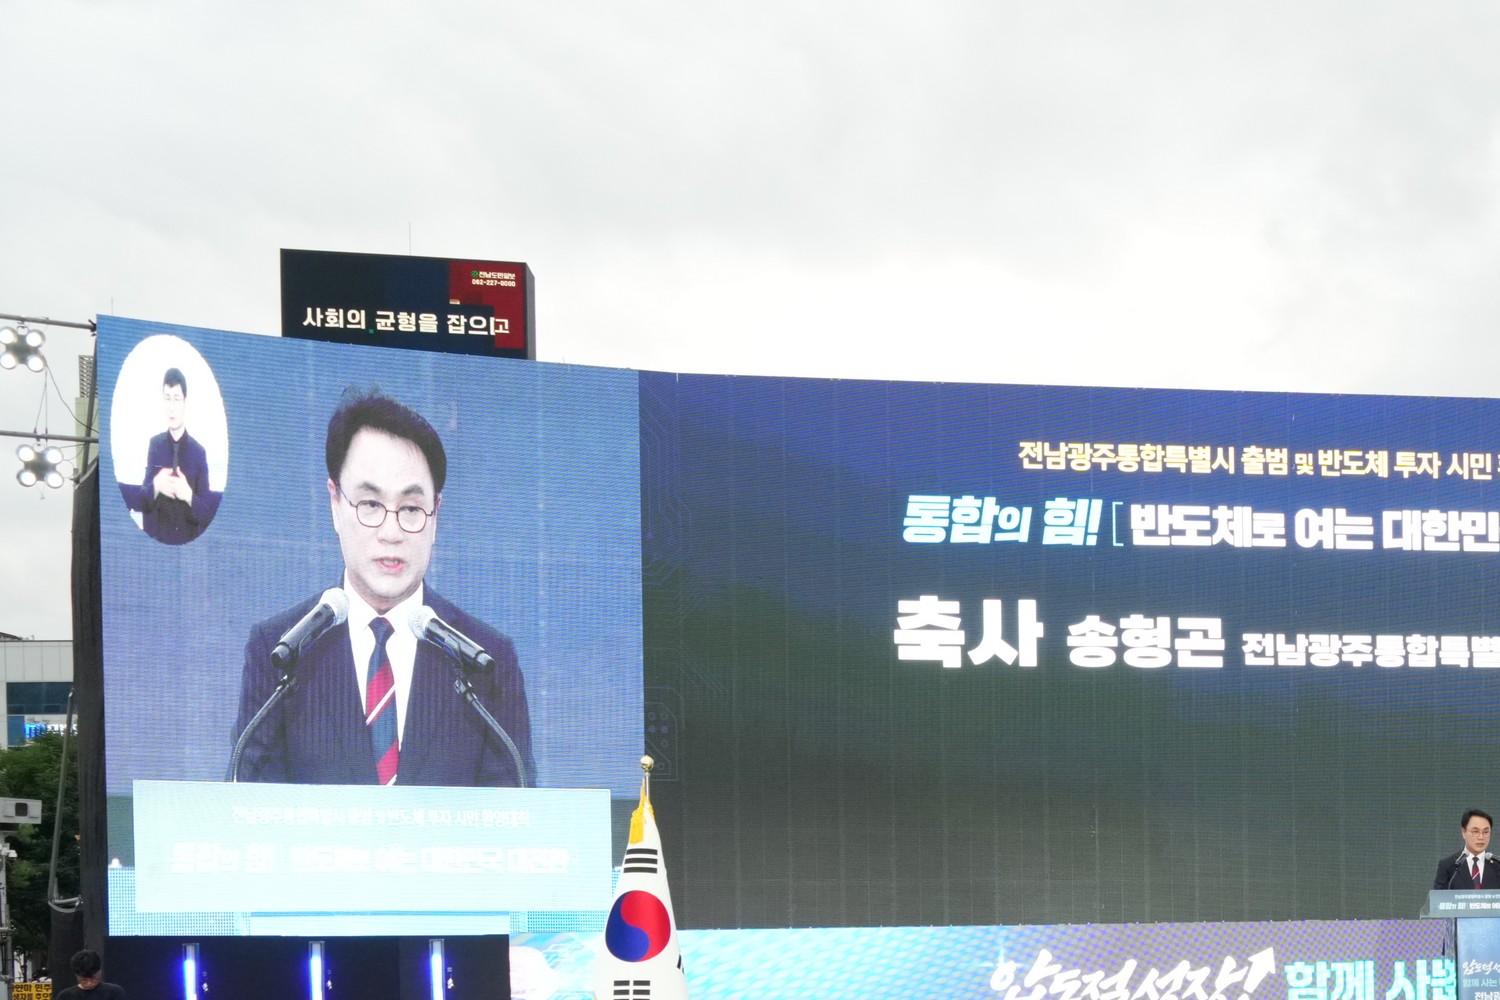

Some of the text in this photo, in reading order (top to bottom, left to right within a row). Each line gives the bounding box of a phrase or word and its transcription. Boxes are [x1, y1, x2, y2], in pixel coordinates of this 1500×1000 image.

[302, 307, 366, 330] 사회의
[375, 310, 438, 334] 균형을
[1018, 440, 1236, 475] 전남광주통합특별시
[1240, 445, 1289, 476] 출범
[1294, 452, 1315, 477] 및
[1317, 449, 1390, 478] 반도체
[1393, 451, 1442, 480] 투자
[1446, 452, 1493, 481] 시민
[902, 494, 1032, 545] 통합의
[1041, 496, 1104, 547] 힘!
[1294, 508, 1374, 551] 여는
[893, 595, 1045, 669] 축사
[1066, 614, 1226, 669] 송형곤
